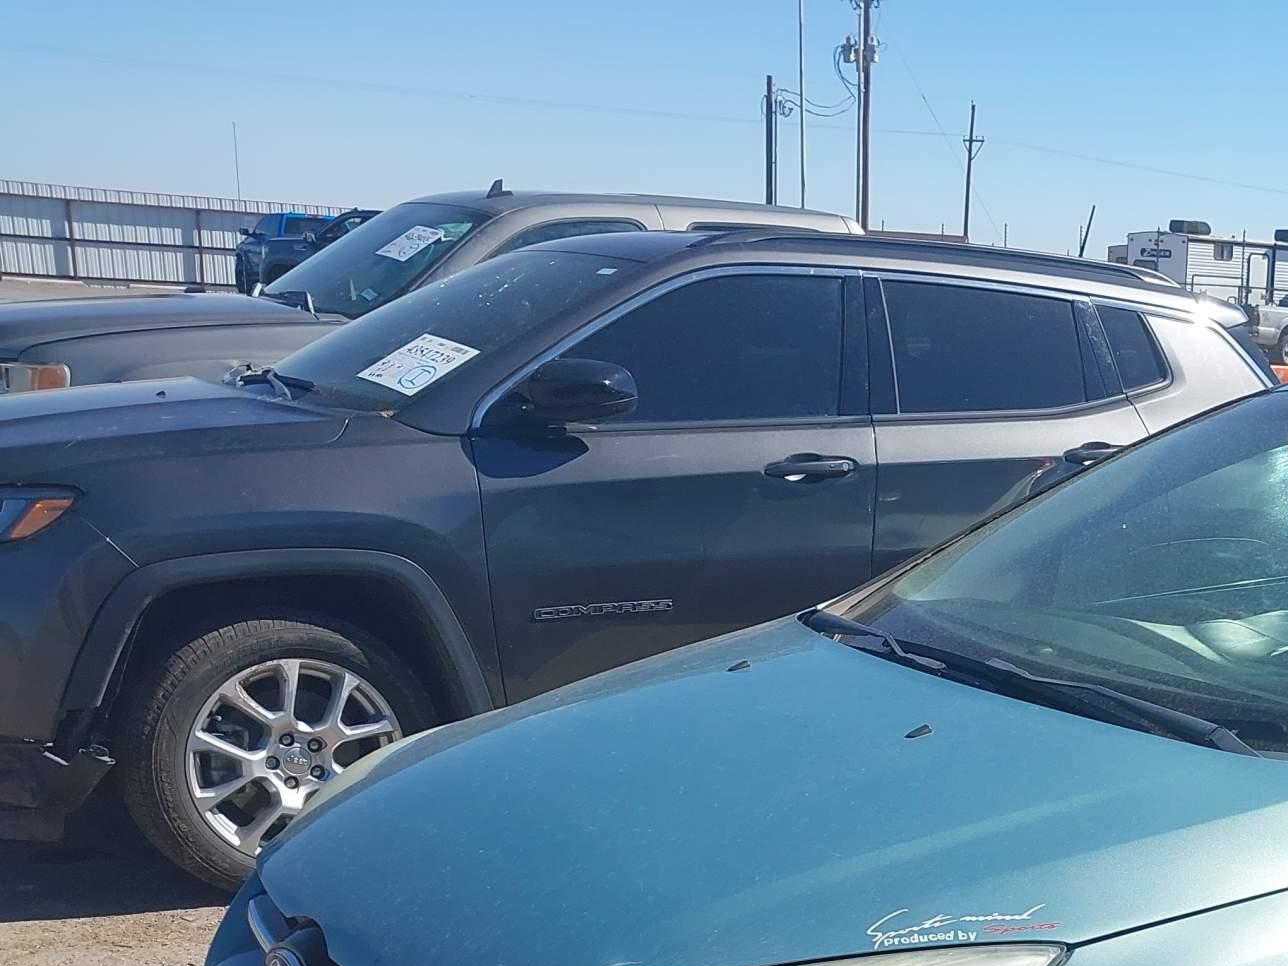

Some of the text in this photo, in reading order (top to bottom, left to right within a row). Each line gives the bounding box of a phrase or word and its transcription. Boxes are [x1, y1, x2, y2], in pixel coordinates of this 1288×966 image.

[534, 599, 673, 620] COMPASS
[884, 930, 954, 947] produced
[957, 930, 977, 943] by
